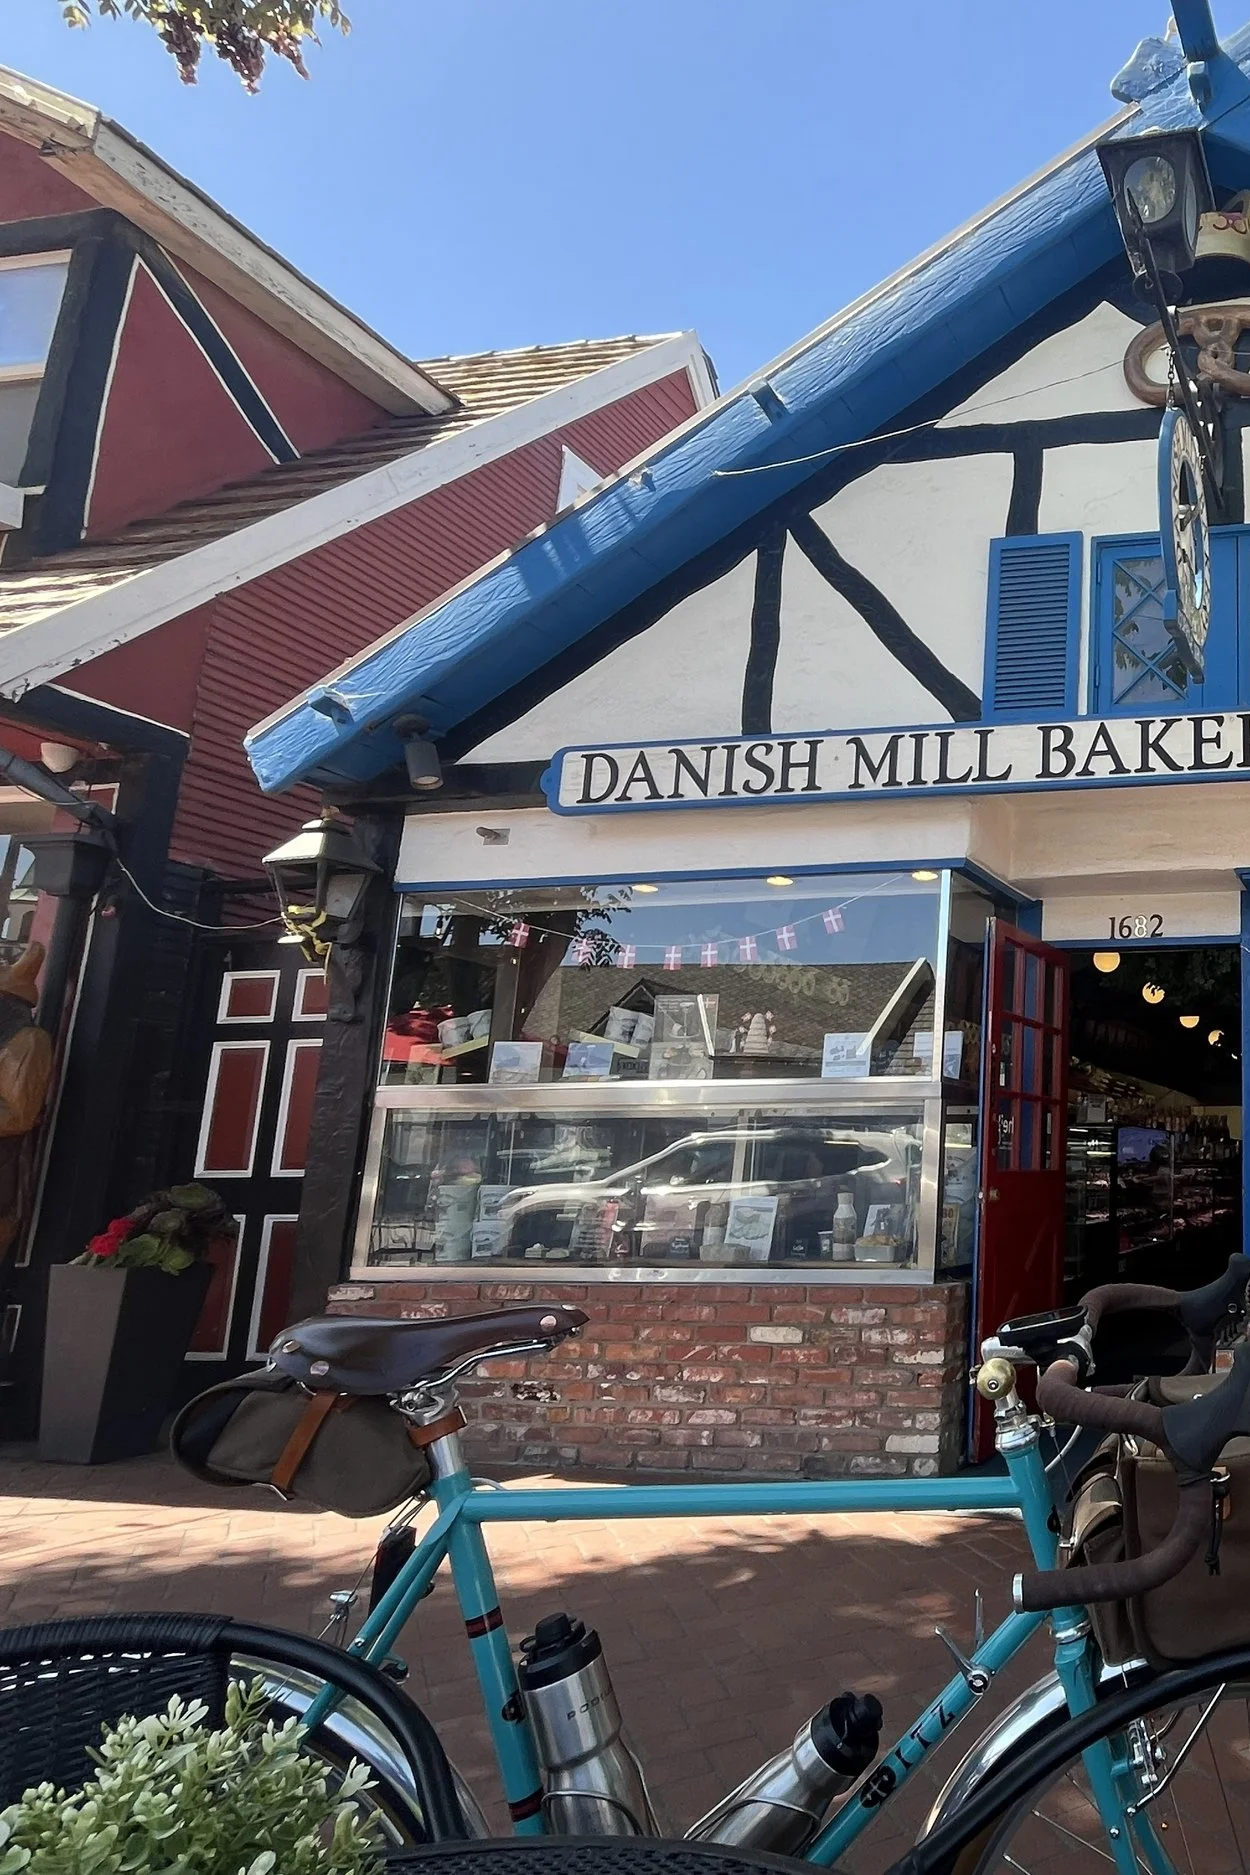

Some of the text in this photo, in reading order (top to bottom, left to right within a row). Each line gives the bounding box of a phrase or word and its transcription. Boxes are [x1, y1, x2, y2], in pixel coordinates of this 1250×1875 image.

[575, 740, 824, 804] DANISH
[847, 728, 1013, 789] MILL
[1108, 914, 1164, 940] 1682
